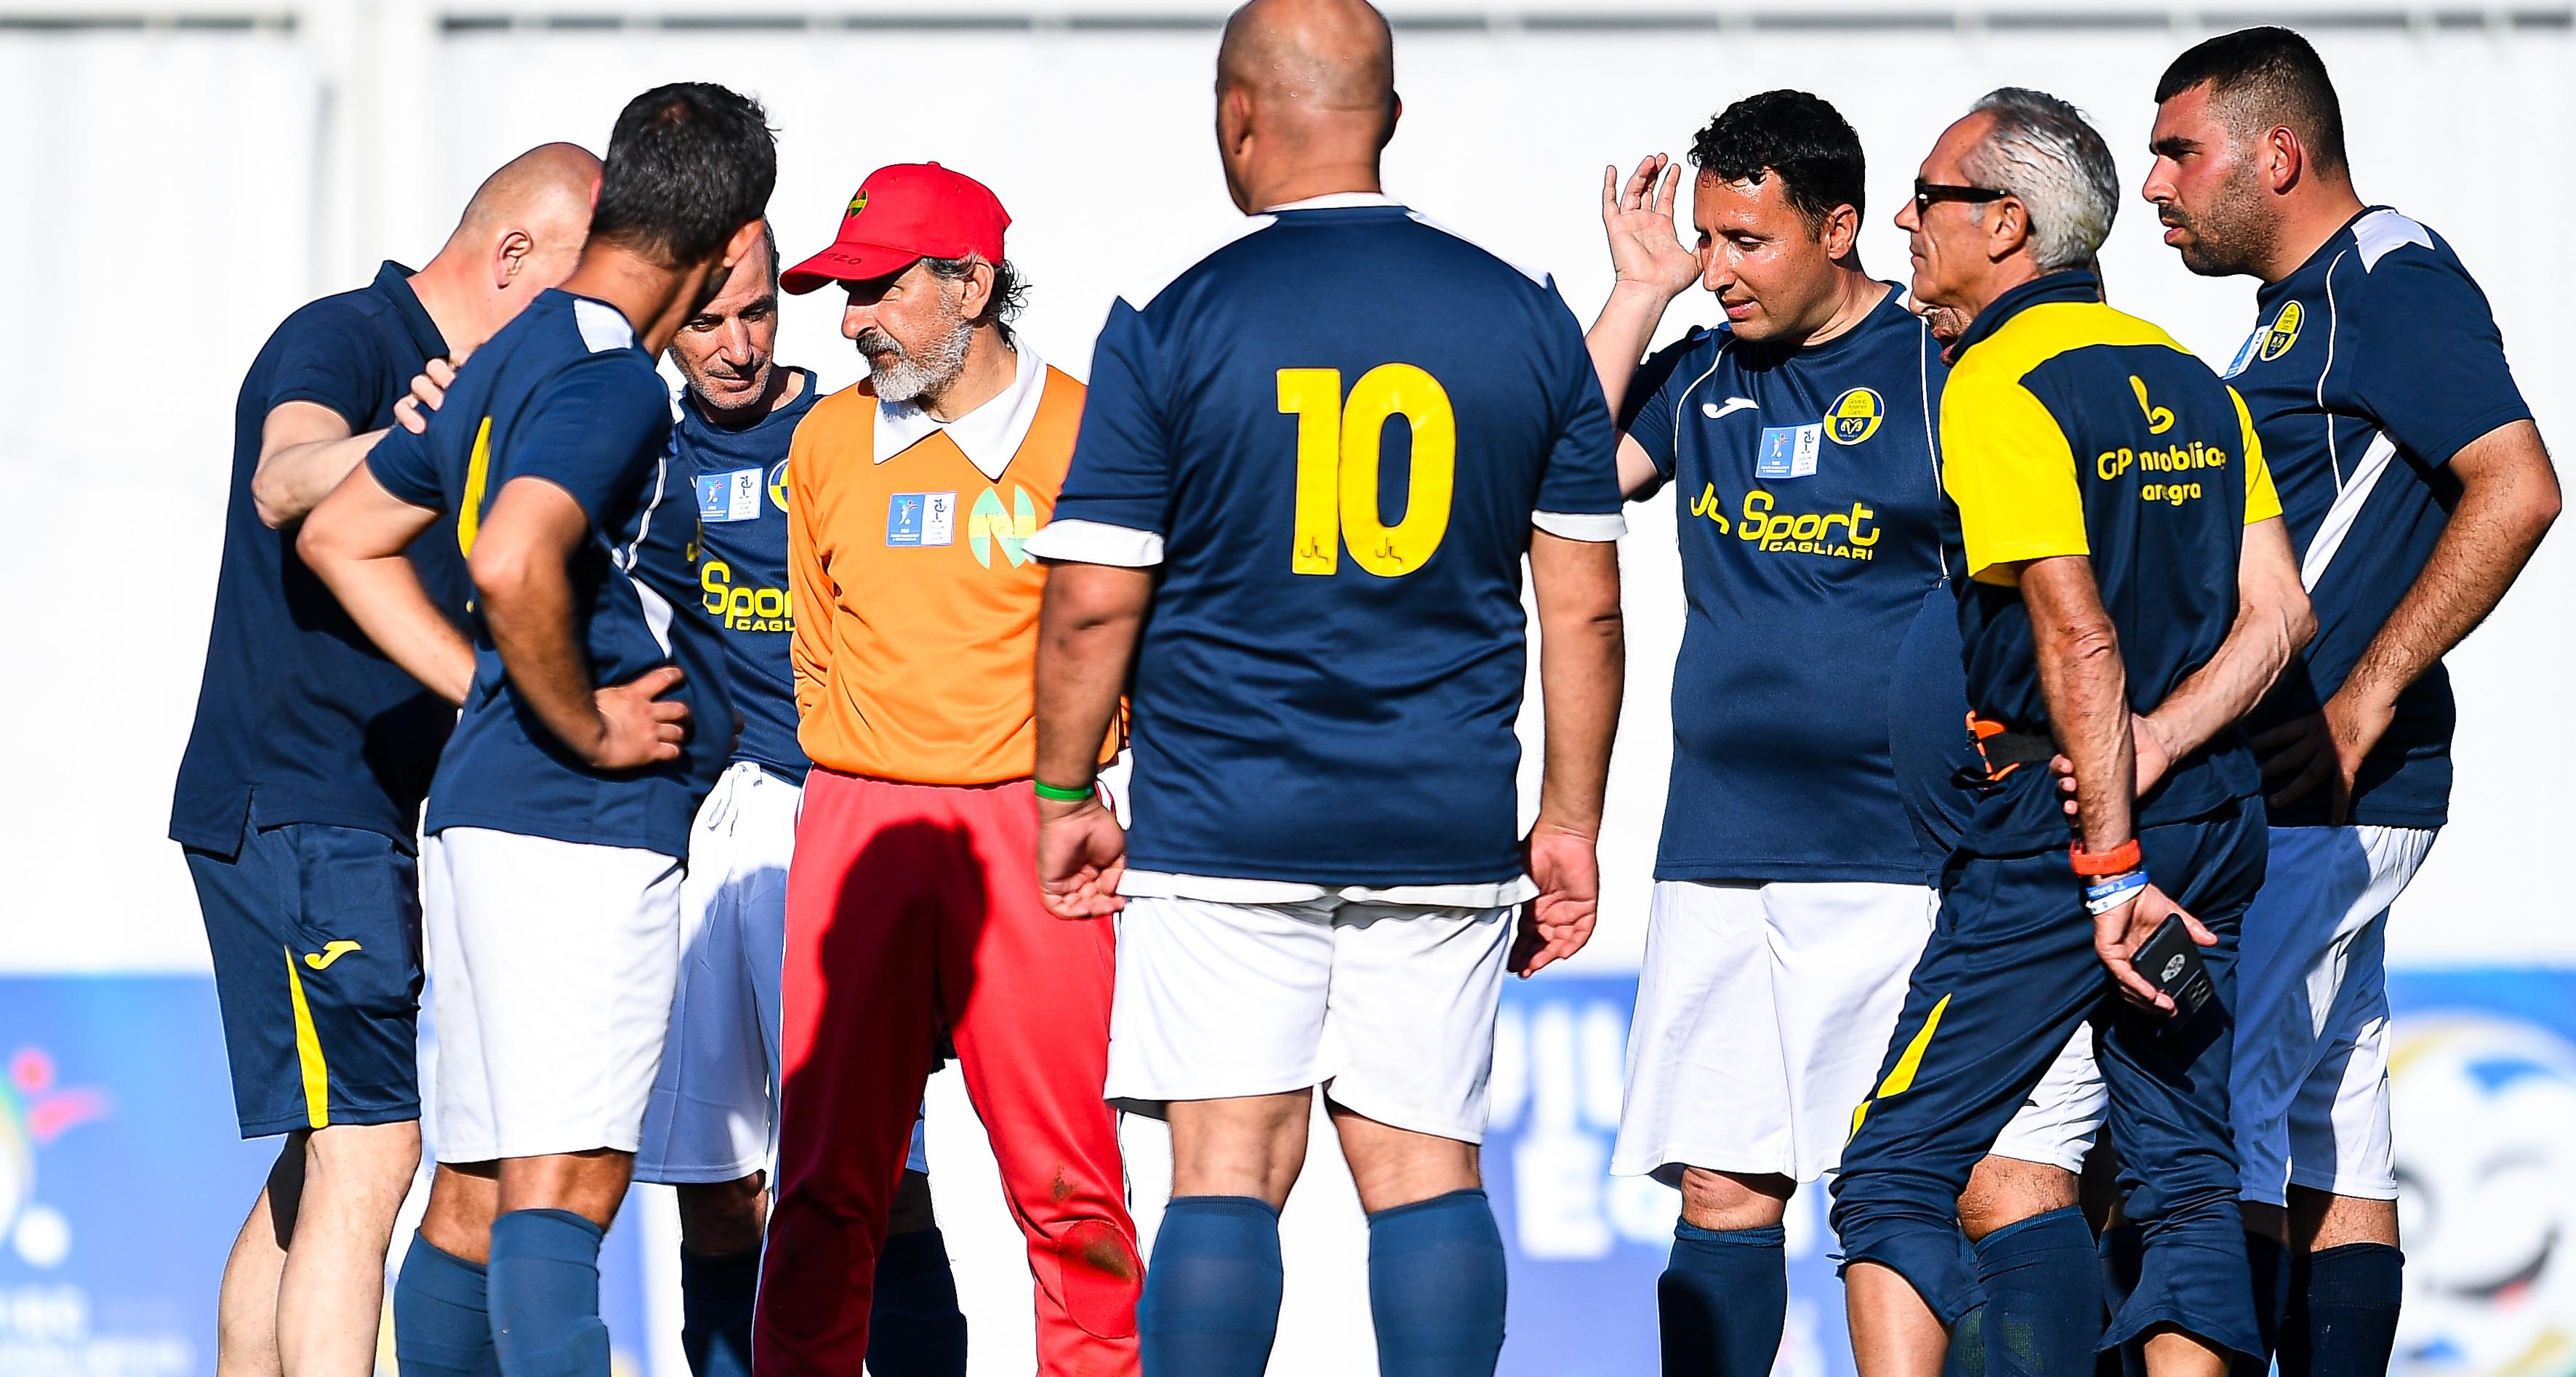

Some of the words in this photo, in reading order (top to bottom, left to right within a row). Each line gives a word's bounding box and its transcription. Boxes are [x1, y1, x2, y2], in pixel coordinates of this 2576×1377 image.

[1276, 362, 1456, 577] 10
[2098, 448, 2132, 480] GP
[1738, 491, 1880, 551] Sport
[1768, 541, 1874, 560] CAGLIARI
[701, 561, 793, 628] Spor
[736, 619, 795, 632] CAGL
